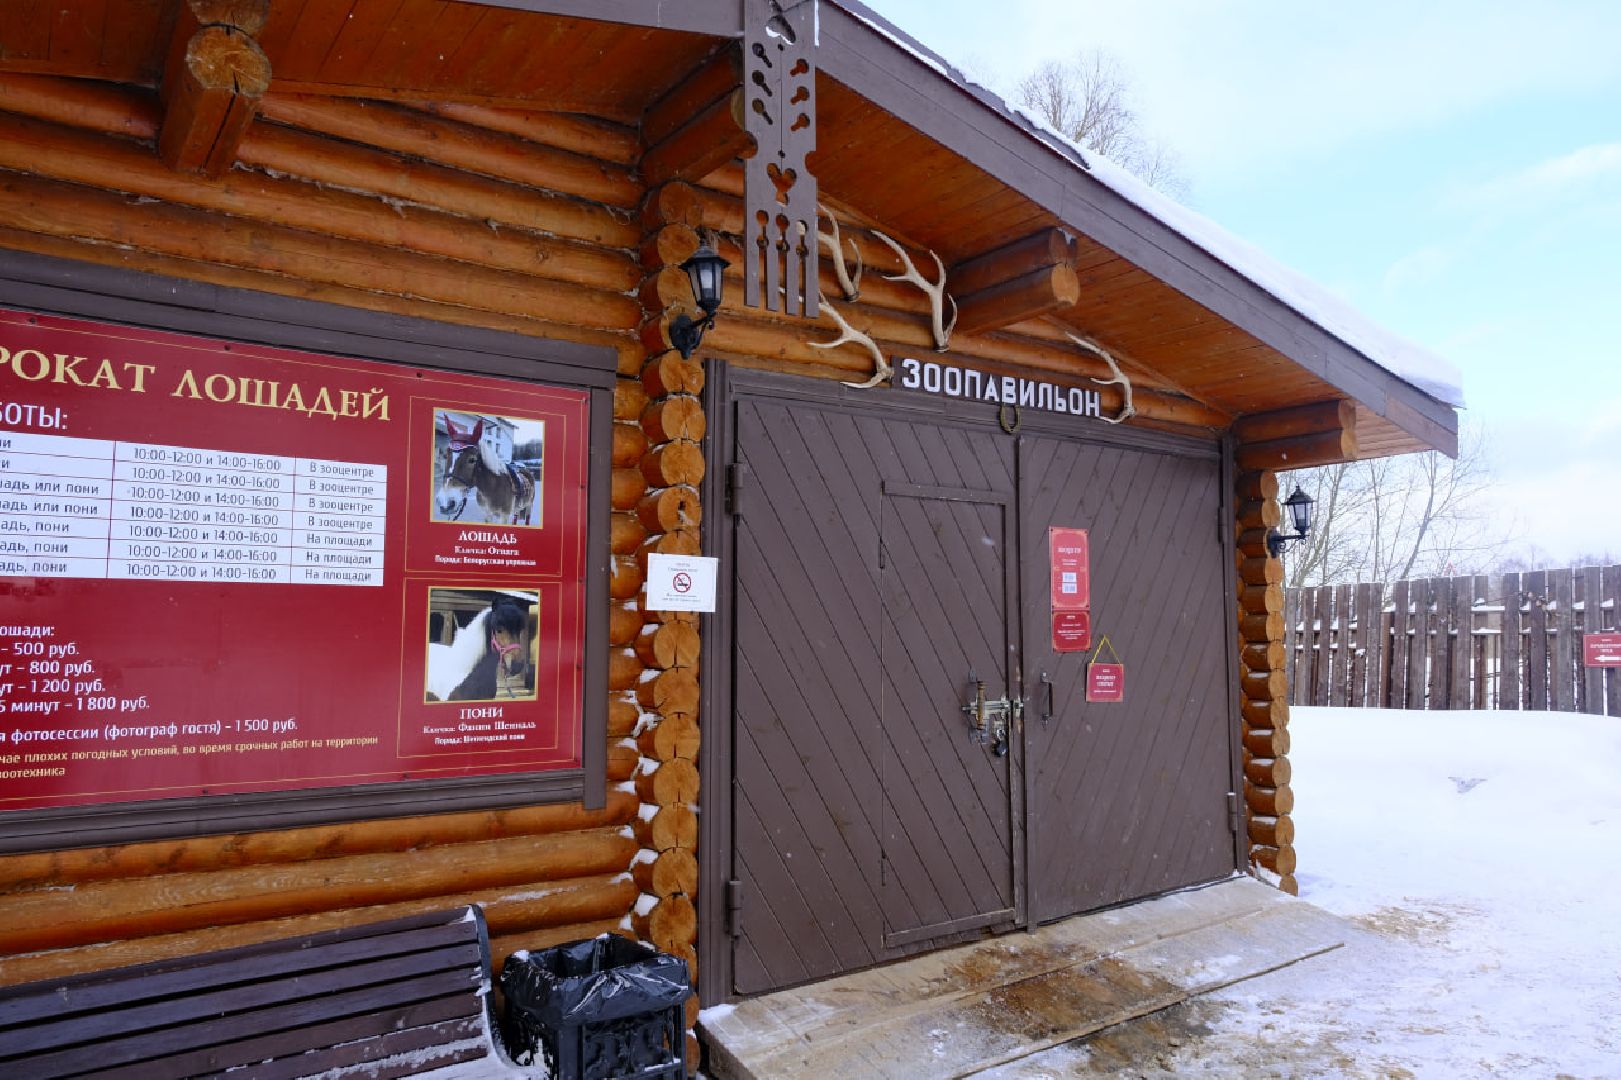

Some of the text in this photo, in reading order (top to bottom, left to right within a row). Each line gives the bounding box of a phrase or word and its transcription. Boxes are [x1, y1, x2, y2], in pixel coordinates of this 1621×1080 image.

[169, 369, 391, 421] ЛОШАДЕЙ
[901, 358, 1100, 417] ЗООПАВИЛЬОН
[0, 402, 68, 430] ОТЫ:
[134, 448, 202, 464] 10:00-12:00
[206, 457, 213, 465] и
[218, 455, 281, 470] 14:00-16:00
[310, 461, 316, 473] В
[320, 465, 374, 478] зооцентре
[133, 467, 201, 483] 10:00-12:00
[205, 476, 212, 484] и
[216, 474, 280, 488] 14:00-16:00
[309, 480, 316, 490] В
[320, 482, 374, 495] зооцентре
[0, 480, 373, 514] адь или пони 10:00-12:00 и 14:00-16:00 В зооцентре
[0, 500, 373, 531] адь или пони 10:00-12:00 и 14:00-16:00 В зооцентре
[35, 521, 70, 532] пони
[130, 525, 198, 540] 10:00-12:00
[202, 532, 209, 540] и
[214, 530, 278, 543] 14:00-16:00
[306, 533, 321, 544] На
[324, 535, 373, 547] площади
[458, 530, 517, 544] ЛОШАДЬ
[34, 542, 69, 553] пони
[128, 544, 197, 558] 10:00-12:00
[201, 551, 208, 559] и
[213, 549, 277, 561] 14:00-16:00
[306, 551, 320, 561] На
[323, 554, 372, 565] площади
[32, 562, 67, 573] пони
[127, 563, 196, 577] 10:00-12:00
[200, 570, 207, 578] и
[212, 567, 276, 579] 14:00-16:00
[305, 569, 320, 579] На
[323, 571, 372, 582] площади
[13, 642, 44, 655] 500
[49, 642, 80, 658] руб.
[29, 661, 60, 674] 800
[64, 660, 95, 677] руб.
[74, 678, 106, 696] руб.
[11, 700, 61, 715] минут
[120, 695, 150, 712] руб.
[459, 707, 503, 720] ПОНИ
[11, 728, 99, 744] фотосессии
[104, 722, 178, 740] (фотограф
[182, 720, 221, 736] гостя)
[272, 717, 298, 734] руб.
[25, 751, 67, 763] плохих
[71, 749, 128, 761] погодных
[131, 745, 180, 759] условий,
[182, 745, 196, 754] во
[200, 743, 232, 755] время
[235, 741, 278, 754] срочных
[281, 738, 308, 751] работ
[311, 739, 323, 749] на
[326, 736, 378, 749] территории
[0, 766, 65, 779] оотехника
